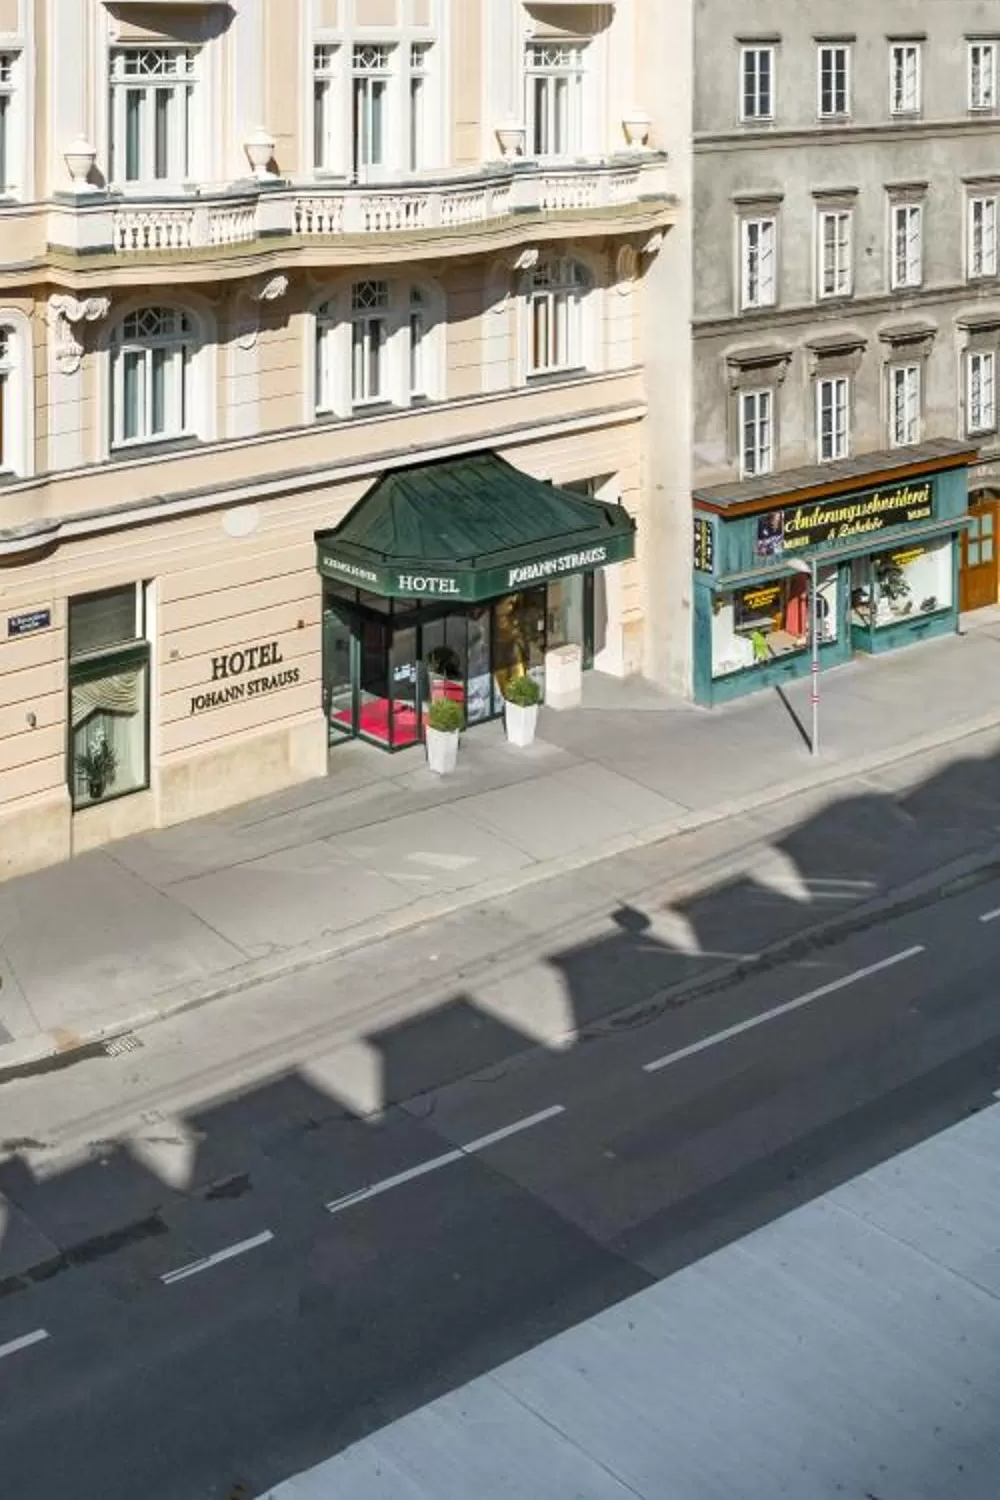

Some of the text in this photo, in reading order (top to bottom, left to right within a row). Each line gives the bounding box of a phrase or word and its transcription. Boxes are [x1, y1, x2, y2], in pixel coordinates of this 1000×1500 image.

[398, 575, 461, 594] HOTEL
[507, 546, 607, 588] JOHANN STRAUSS
[210, 641, 284, 681] HOTEL
[190, 667, 300, 716] JOHANN STRAUSS
